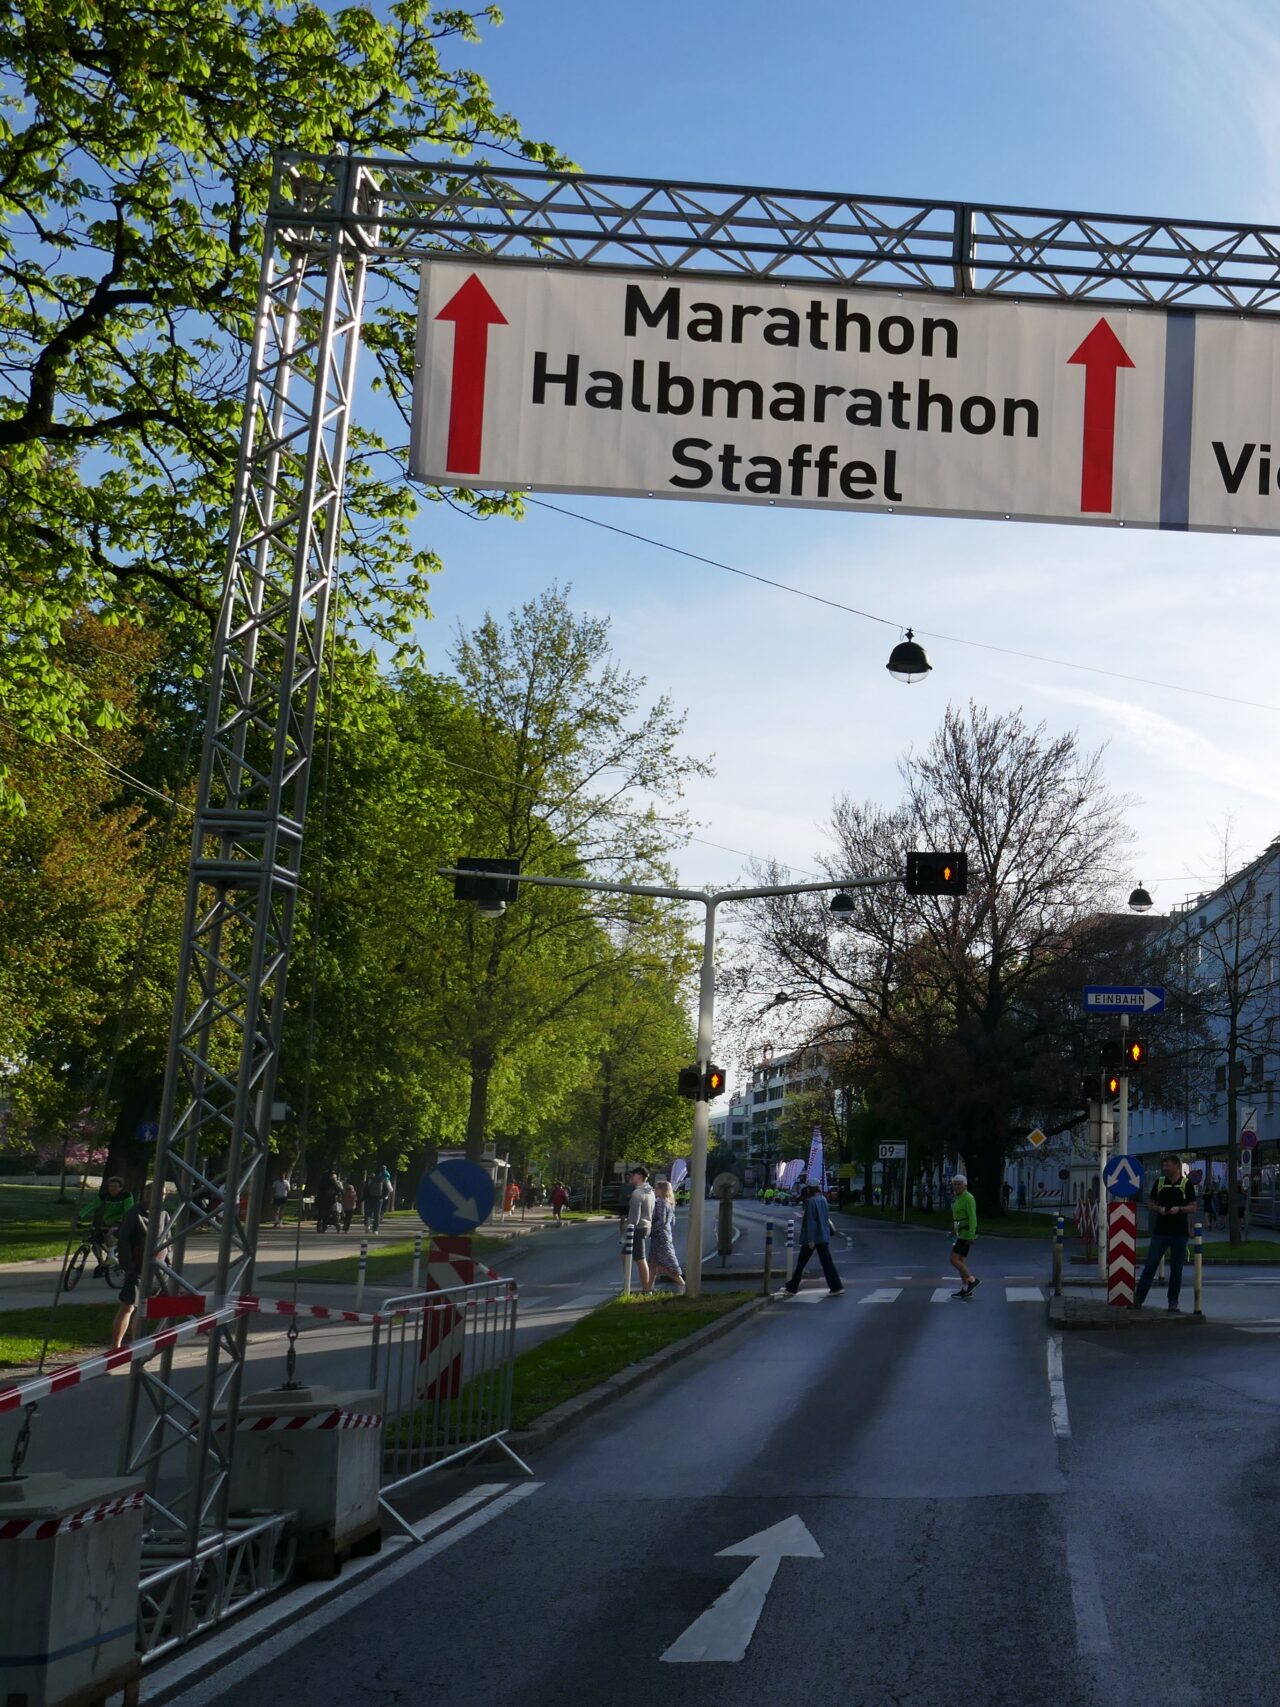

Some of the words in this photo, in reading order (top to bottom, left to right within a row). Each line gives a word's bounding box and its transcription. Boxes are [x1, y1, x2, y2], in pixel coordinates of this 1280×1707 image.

[624, 284, 958, 358] Marathon
[531, 351, 1040, 438] Halbmarathon
[668, 437, 903, 502] Staffel
[1094, 995, 1145, 1004] EINBAHN
[880, 1146, 895, 1157] 09
